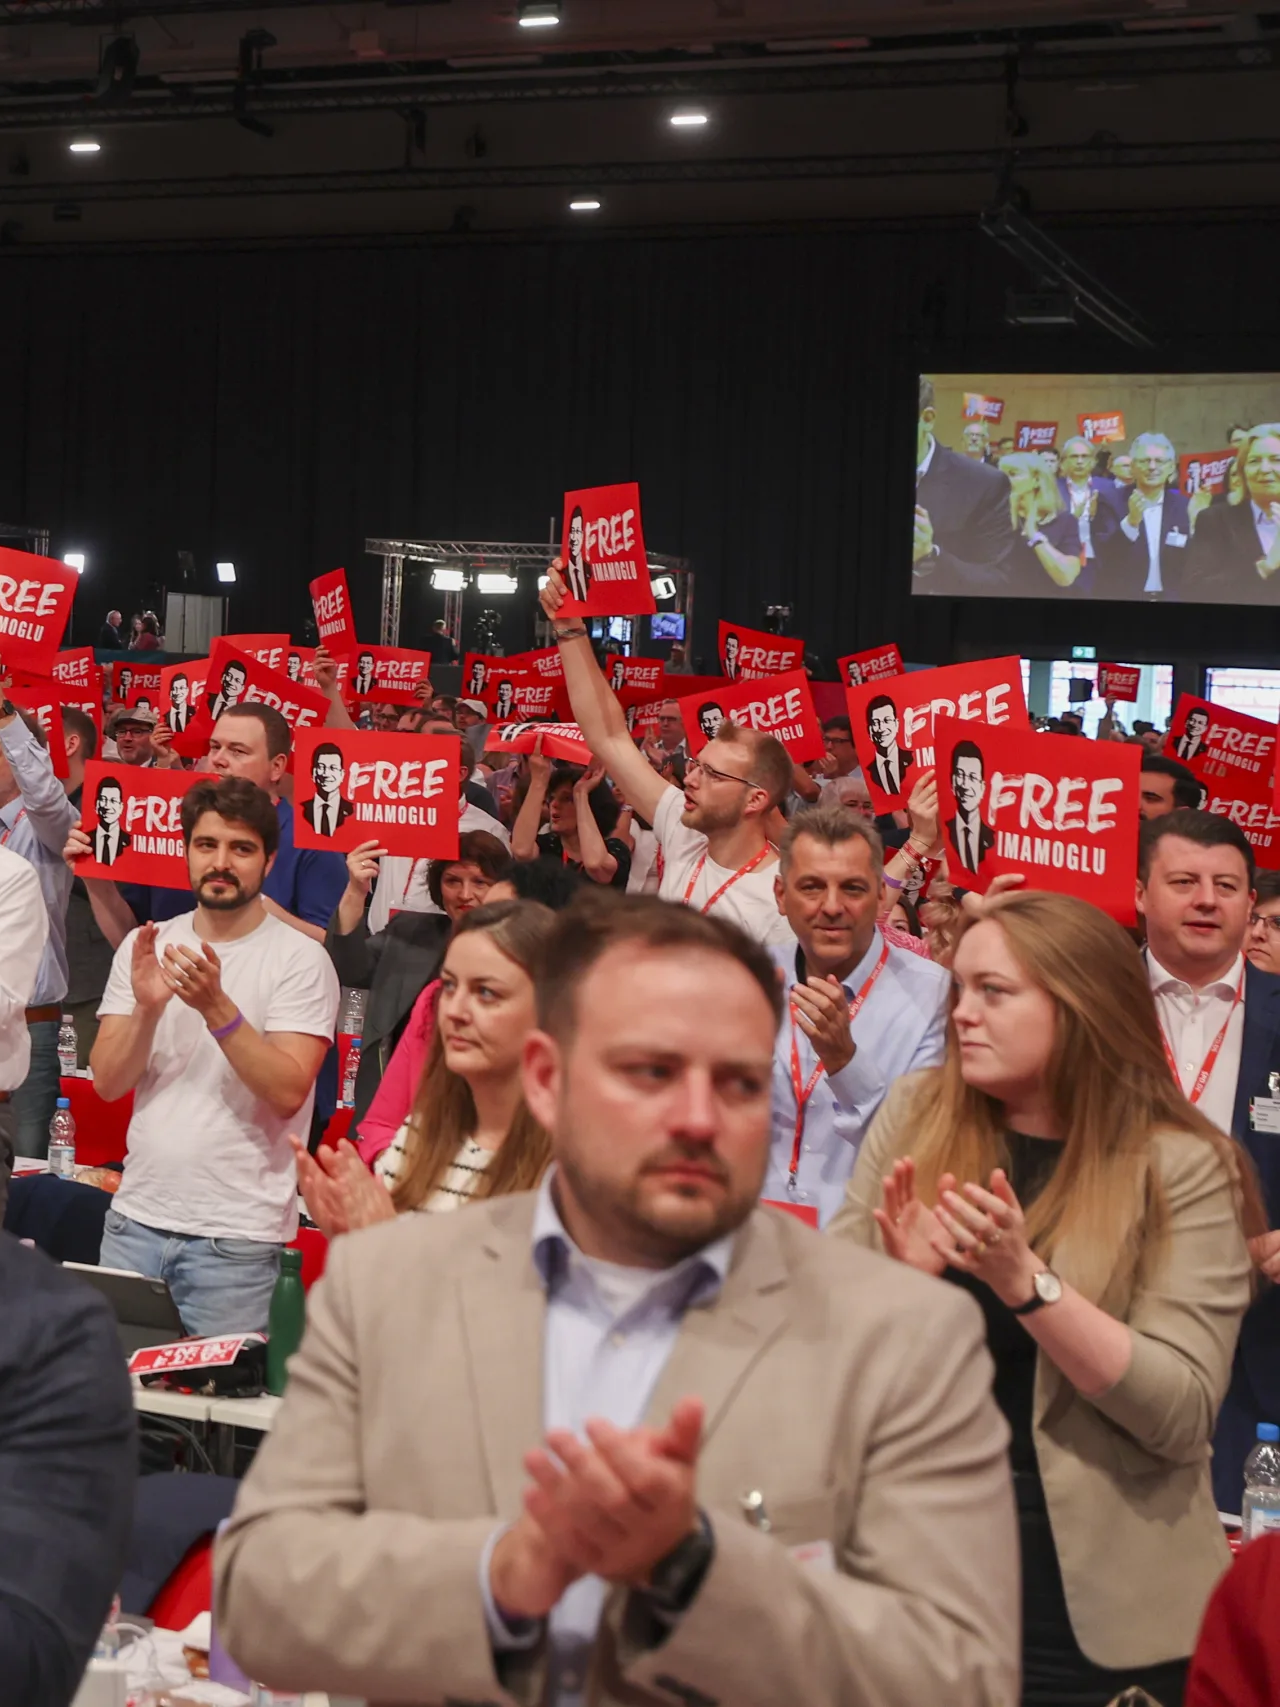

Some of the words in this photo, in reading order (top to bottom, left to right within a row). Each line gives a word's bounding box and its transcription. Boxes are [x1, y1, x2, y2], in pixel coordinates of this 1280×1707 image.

[585, 508, 635, 562] FREE
[592, 561, 637, 581] IMAMOGLU
[375, 660, 425, 679] FREE
[739, 645, 796, 671] FREE
[861, 651, 897, 676] FREE
[133, 674, 161, 689] FRE
[625, 666, 661, 681] FREE
[1106, 672, 1138, 686] FREE
[514, 686, 553, 704] FREE
[729, 688, 803, 730] FREE
[1206, 723, 1276, 757] FREE
[1207, 746, 1262, 773] IMAMOGLU
[347, 759, 448, 801] FREE
[126, 795, 184, 833] FRE
[355, 802, 437, 826] IMAMOGLU
[988, 771, 1124, 834] FREE
[133, 834, 185, 857] IMAMOG
[997, 831, 1107, 875] IMAMOGLU
